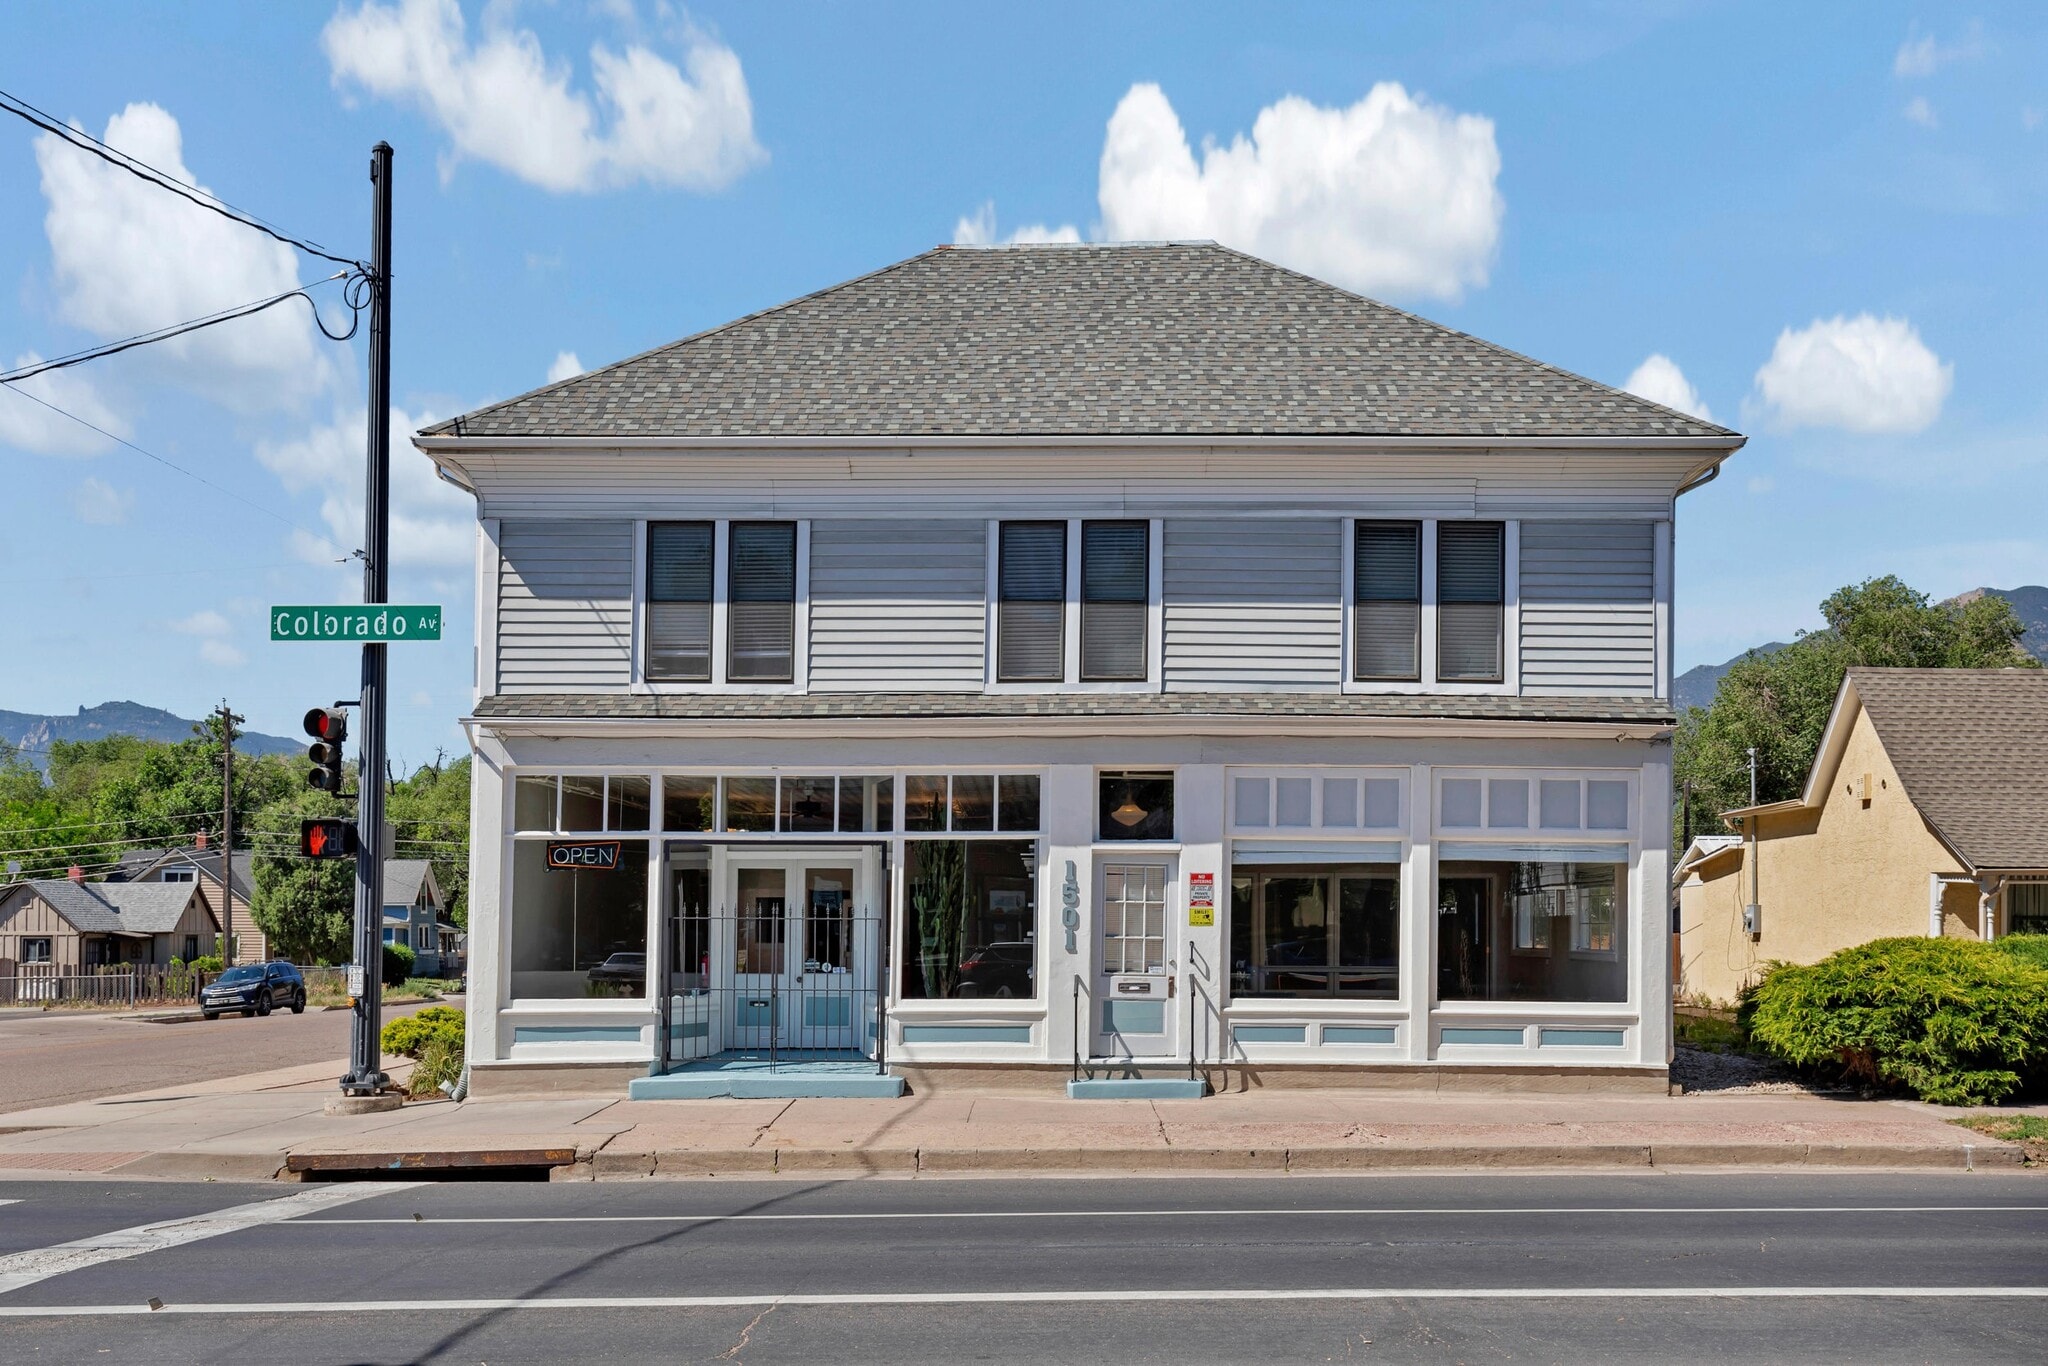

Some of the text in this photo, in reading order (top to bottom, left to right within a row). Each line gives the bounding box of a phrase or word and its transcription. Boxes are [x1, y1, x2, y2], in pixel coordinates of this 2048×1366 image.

[276, 610, 407, 636] Colorado
[553, 847, 613, 864] OPEN
[1062, 860, 1079, 952] 1501
